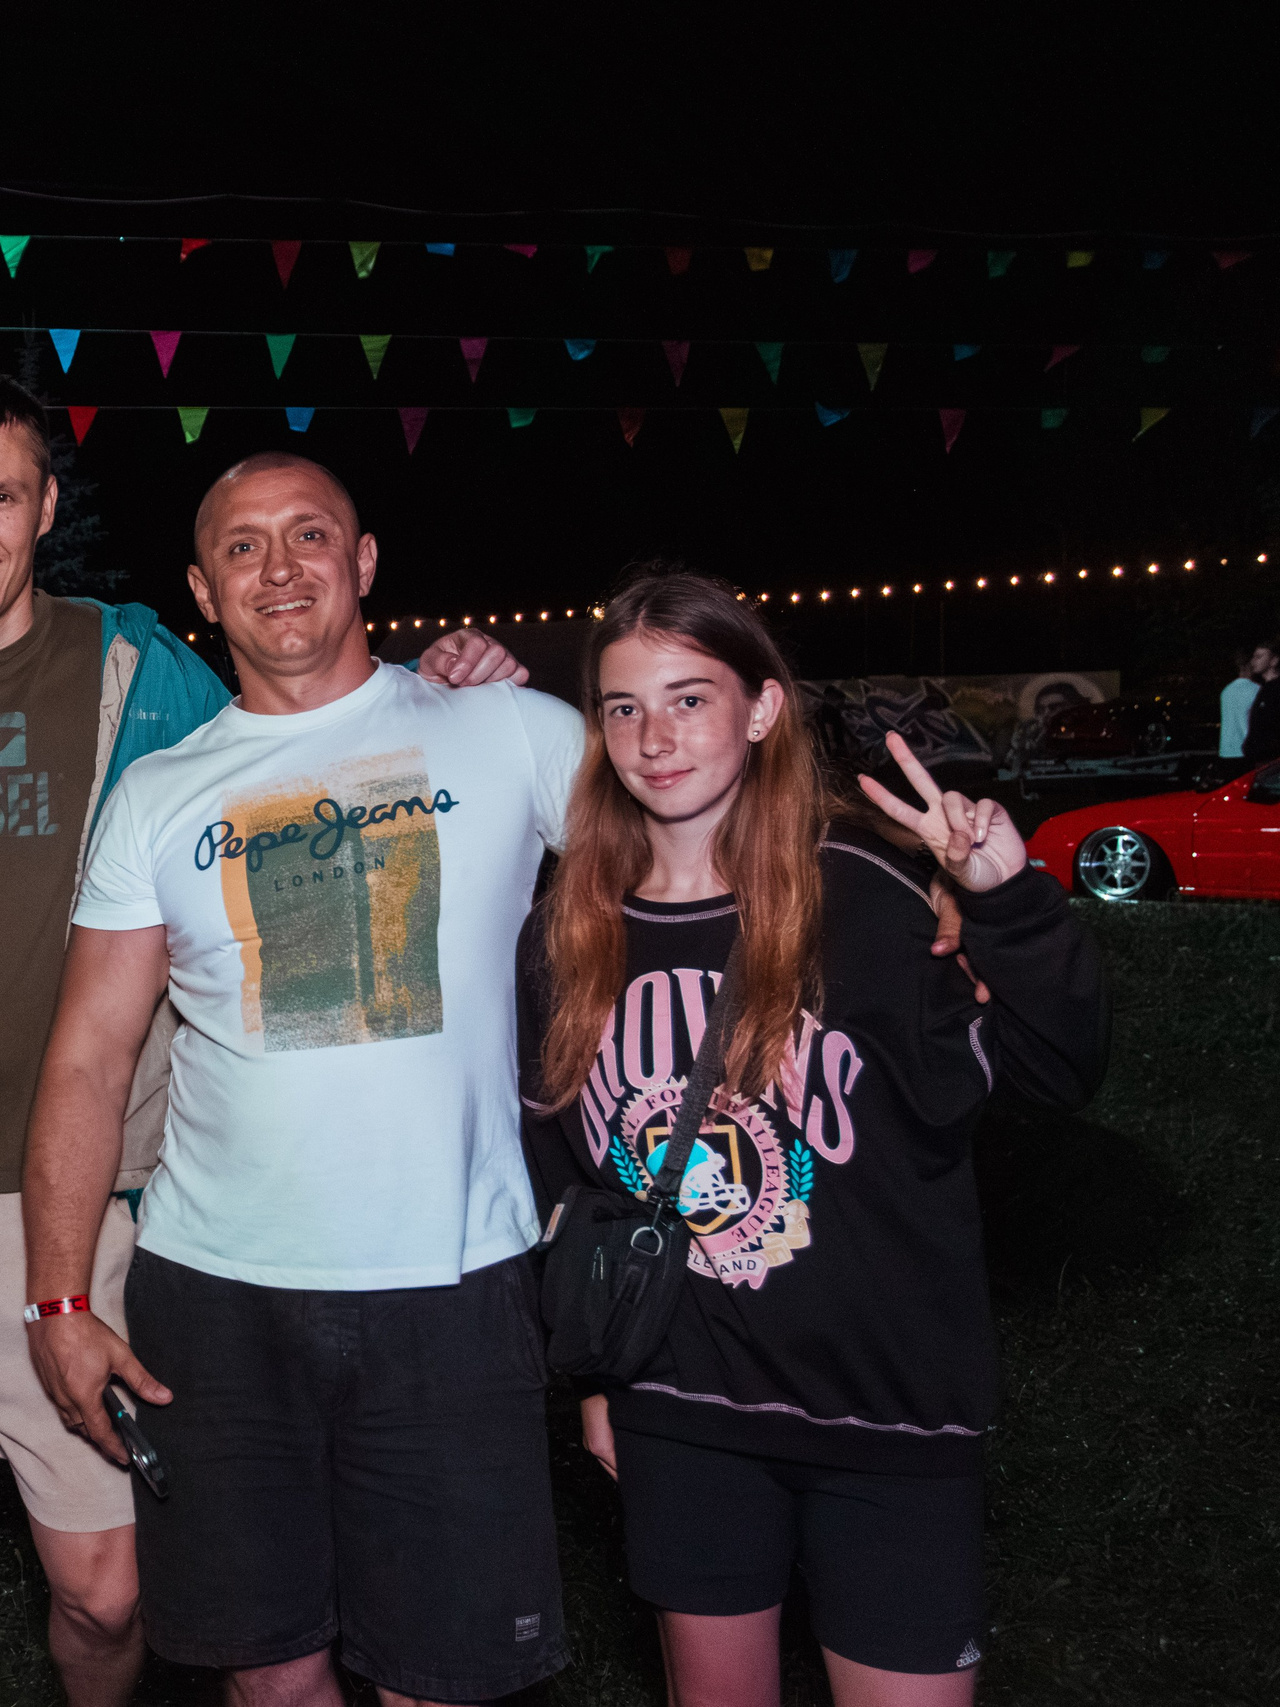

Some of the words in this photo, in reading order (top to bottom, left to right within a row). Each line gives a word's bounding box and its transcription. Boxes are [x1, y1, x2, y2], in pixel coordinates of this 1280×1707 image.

[194, 820, 308, 872] Pepe
[309, 788, 460, 860] Jeans
[273, 855, 386, 893] LONDON
